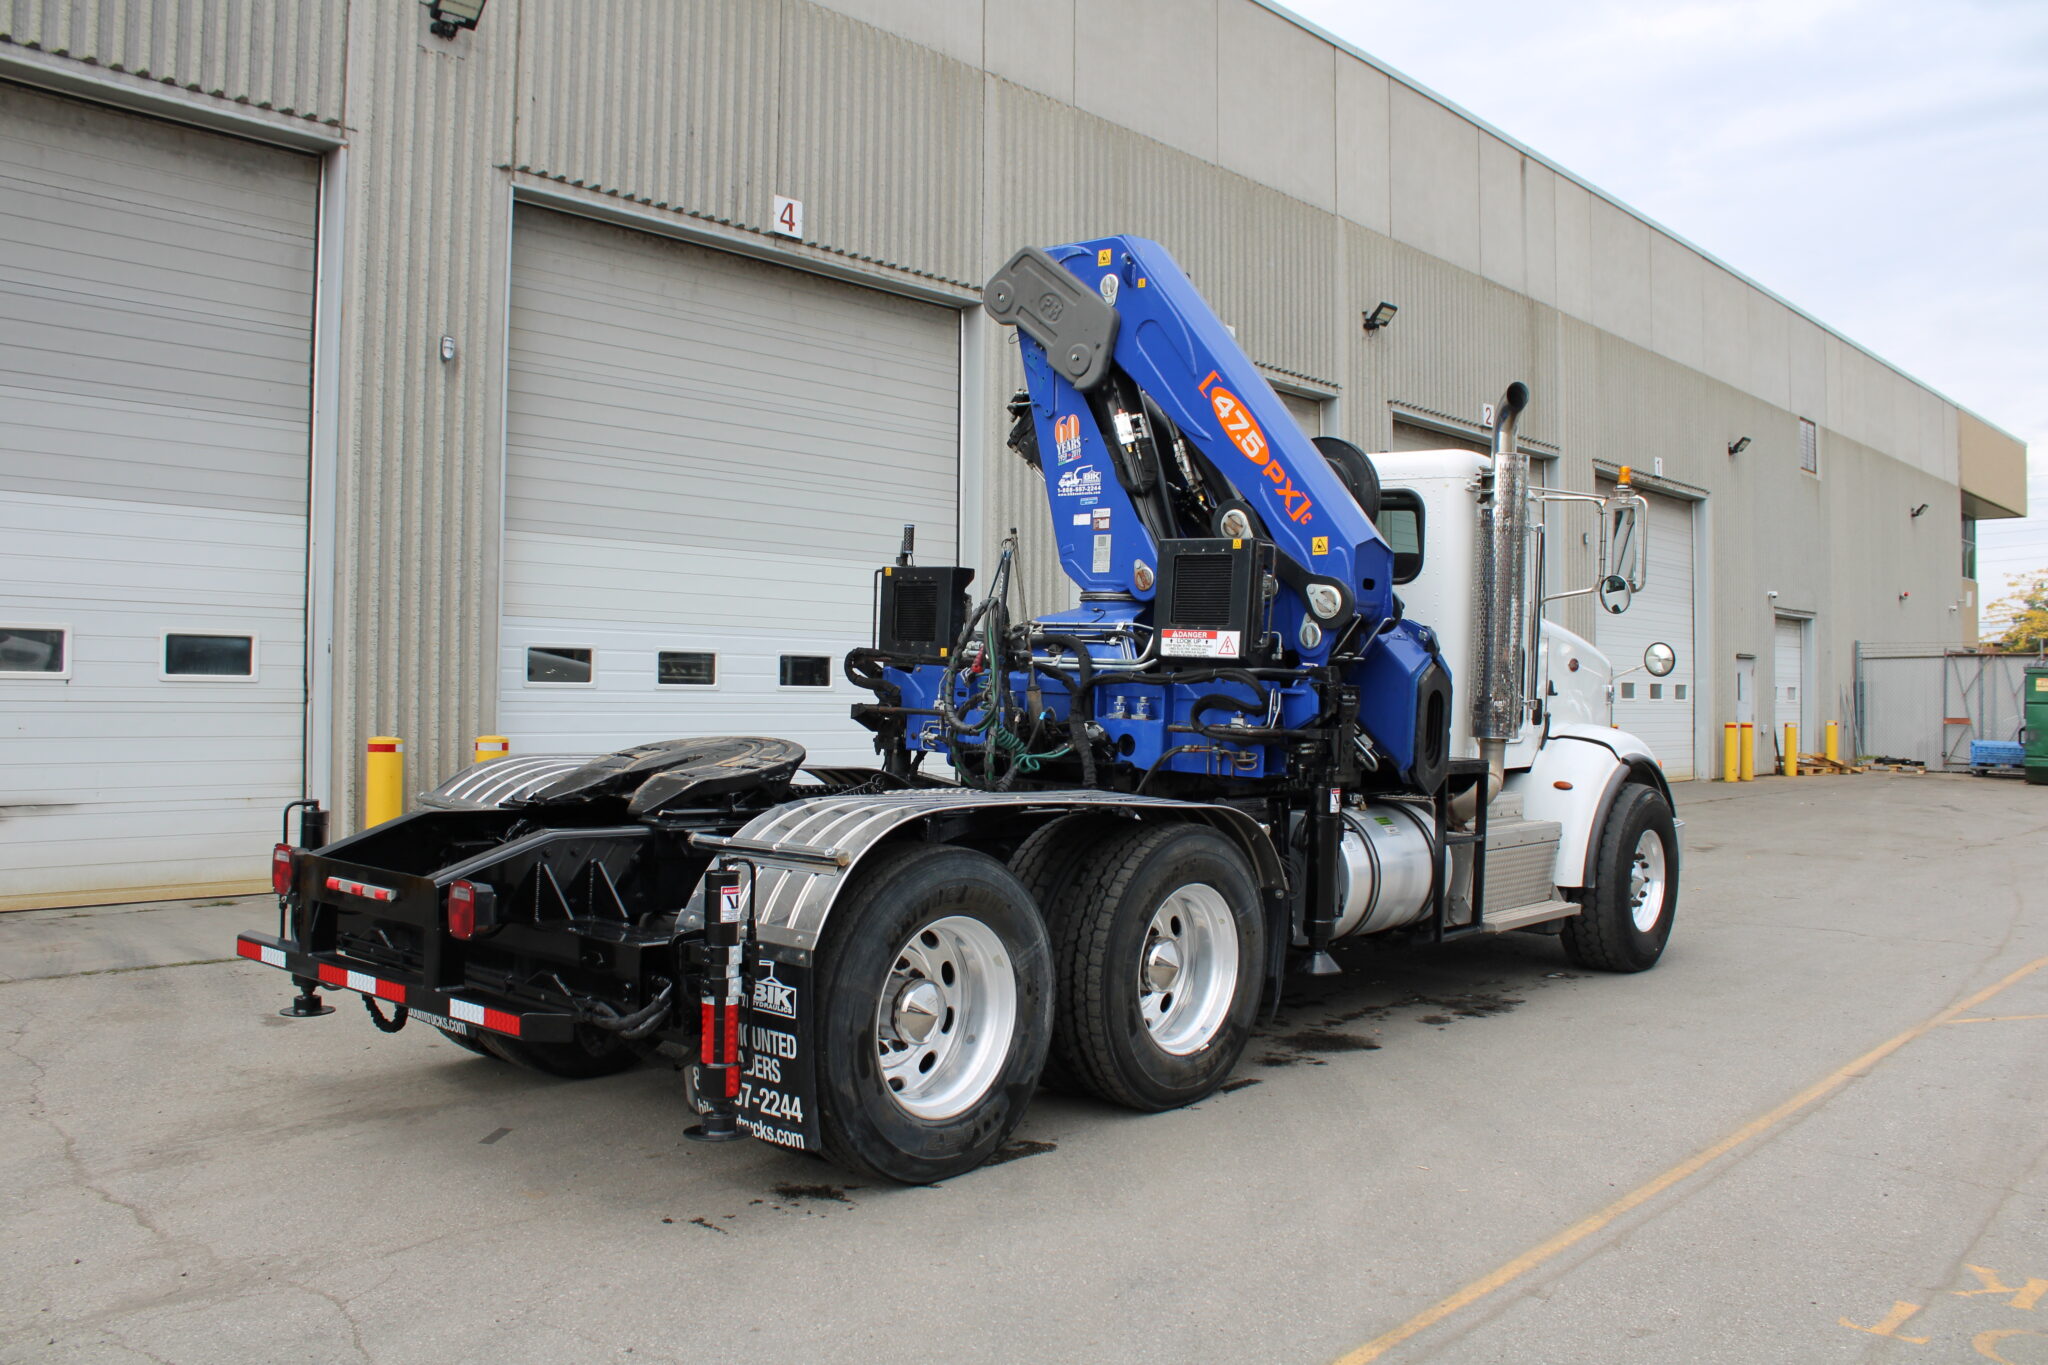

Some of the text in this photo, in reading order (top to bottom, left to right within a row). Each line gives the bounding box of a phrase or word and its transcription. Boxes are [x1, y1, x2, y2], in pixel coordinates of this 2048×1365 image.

[780, 202, 795, 232] 4
[1055, 413, 1080, 444] 60
[1485, 406, 1492, 426] 2
[1056, 435, 1081, 456] YEARS
[753, 983, 792, 1010] BIK
